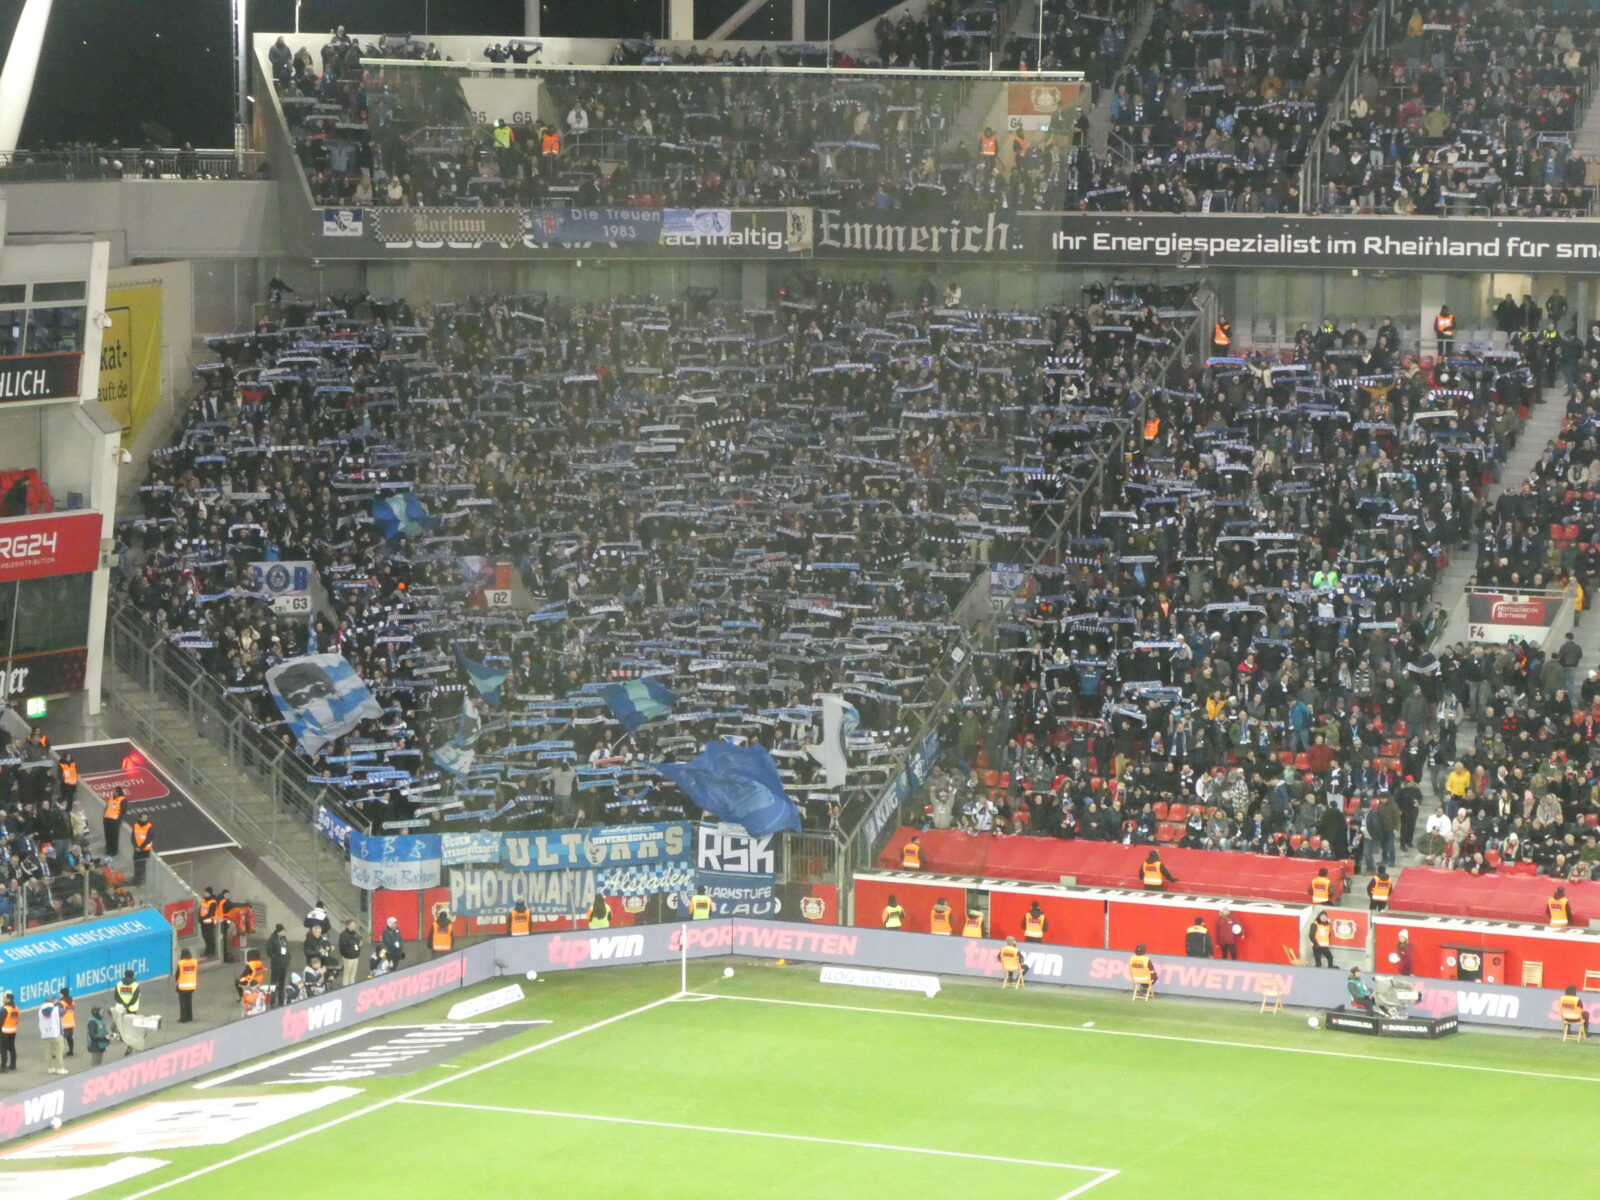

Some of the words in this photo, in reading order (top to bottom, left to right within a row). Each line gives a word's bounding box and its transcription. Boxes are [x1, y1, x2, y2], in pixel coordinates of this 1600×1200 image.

[512, 111, 533, 124] G5
[1010, 118, 1023, 129] G4
[414, 214, 487, 233] Bochum
[571, 208, 599, 221] Die
[605, 208, 661, 222] Treuen
[602, 224, 637, 238] 1983
[818, 209, 1010, 253] Emmerich
[1051, 232, 1087, 251] Ihr
[1093, 233, 1321, 258] Energiespezialist
[1326, 235, 1357, 254] im
[1363, 236, 1501, 257] Rheinland
[1506, 237, 1550, 258] für
[1556, 243, 1600, 258] sm
[0, 531, 58, 559] RG24
[292, 598, 308, 610] G3
[1470, 625, 1485, 639] F4
[698, 828, 775, 874] RSK
[450, 867, 597, 913] PHOTOMAFIA
[3, 938, 68, 960] EINFACH.
[62, 920, 152, 947] MENSCHLICH.
[668, 924, 859, 956] SPORTWETTEN
[20, 976, 72, 1003] EINFACH.
[76, 958, 150, 989] MENSCHLICH.
[81, 1040, 216, 1105] SPORTWETTEN
[356, 957, 468, 1014] SPORTWETTEN
